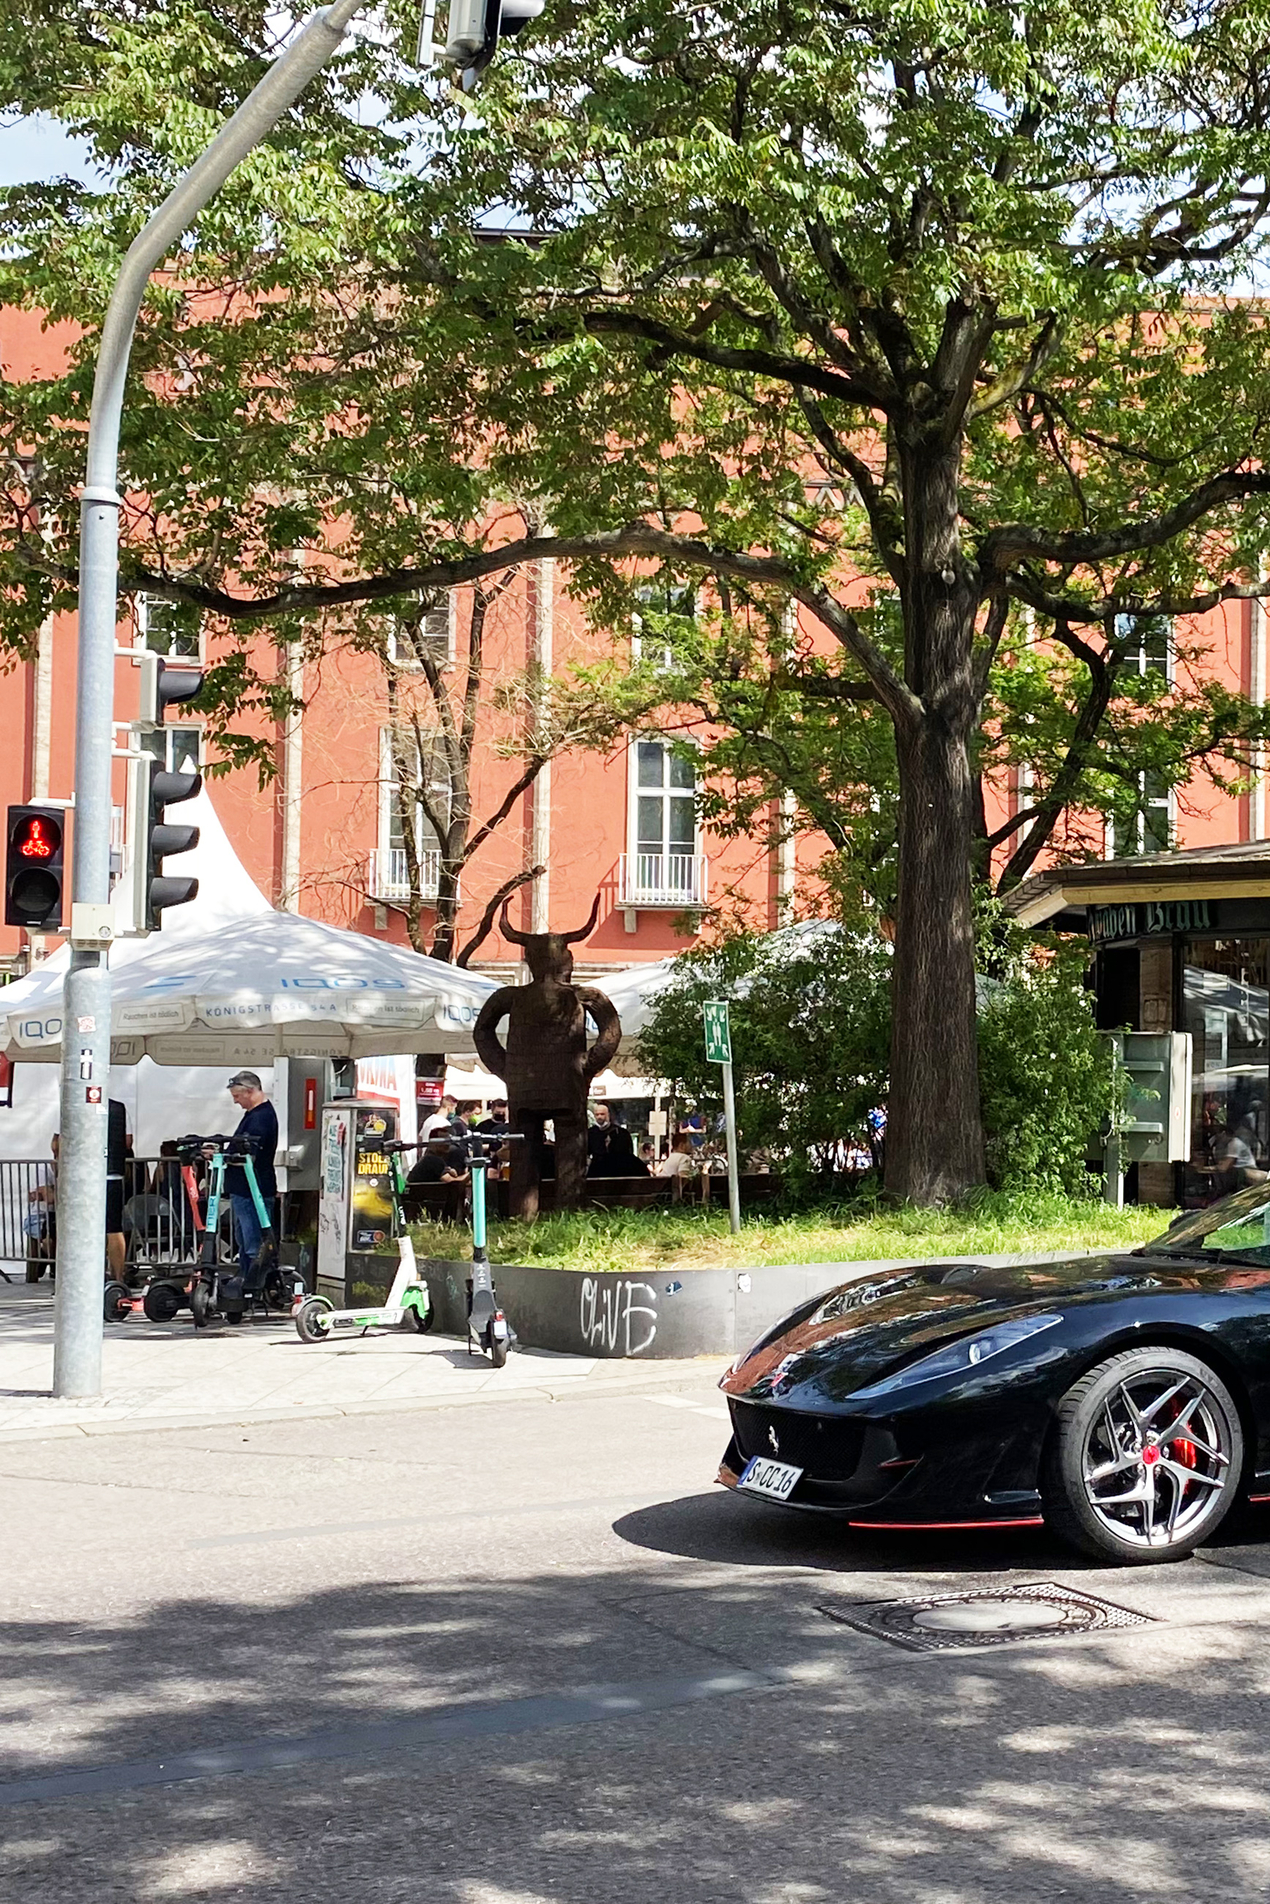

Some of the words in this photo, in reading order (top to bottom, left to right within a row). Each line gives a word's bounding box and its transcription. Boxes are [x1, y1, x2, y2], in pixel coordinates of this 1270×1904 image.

[281, 979, 405, 990] IQOS
[330, 1003, 338, 1012] A
[19, 1018, 63, 1039] IQO
